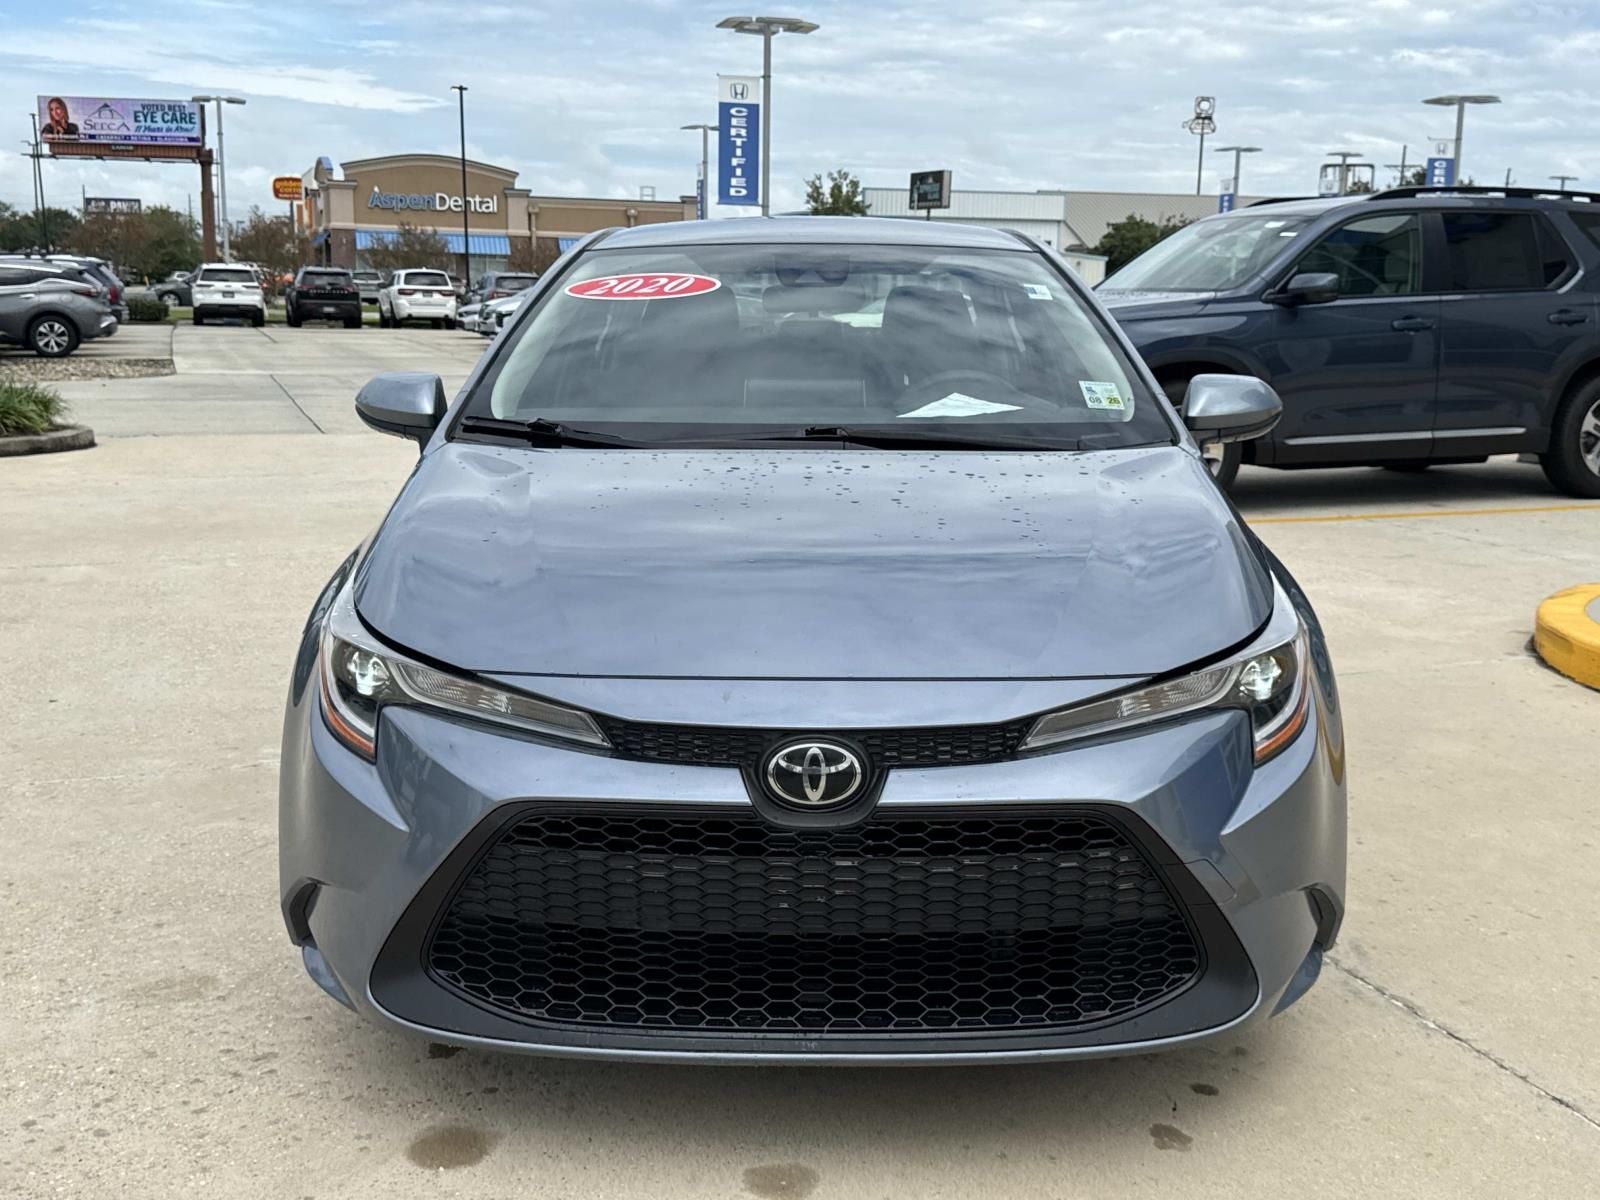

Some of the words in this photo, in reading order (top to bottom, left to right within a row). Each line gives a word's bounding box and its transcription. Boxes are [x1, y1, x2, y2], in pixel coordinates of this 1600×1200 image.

[141, 103, 166, 112] VOTED
[167, 104, 186, 112] BEST
[134, 110, 158, 124] EYE
[161, 112, 197, 125] CARE
[729, 107, 748, 196] CERTIFIED
[584, 276, 696, 296] 2020
